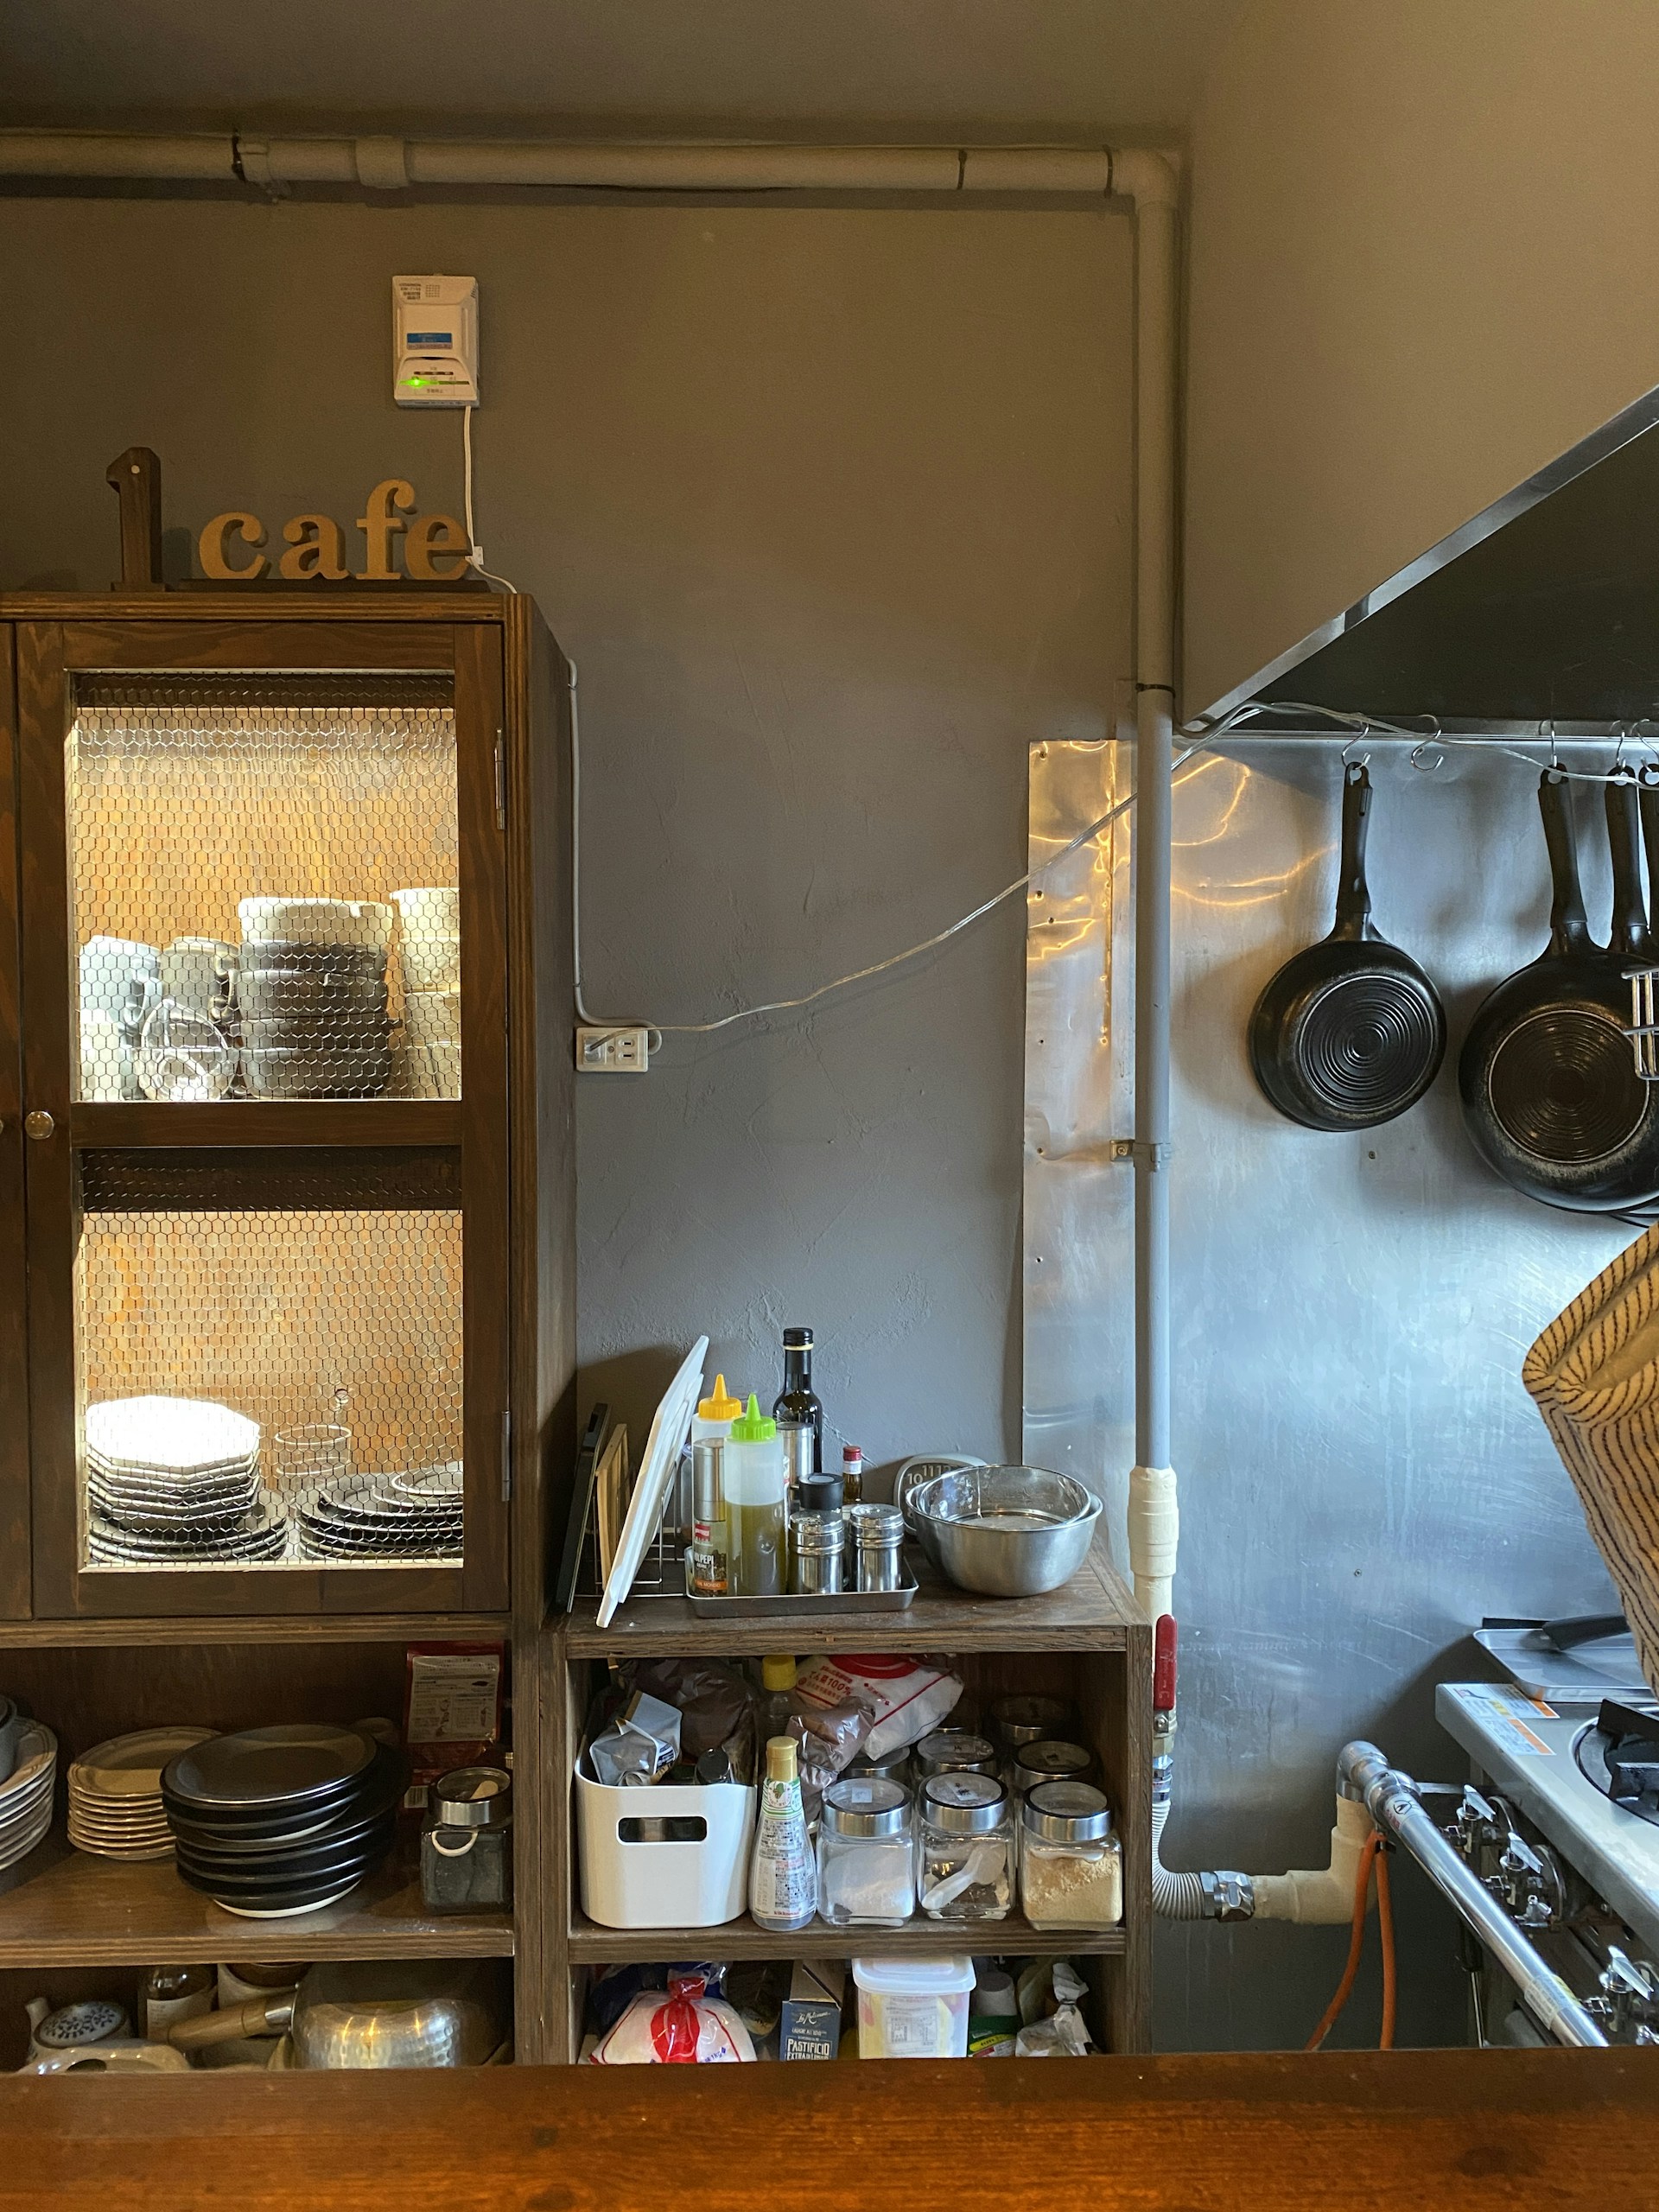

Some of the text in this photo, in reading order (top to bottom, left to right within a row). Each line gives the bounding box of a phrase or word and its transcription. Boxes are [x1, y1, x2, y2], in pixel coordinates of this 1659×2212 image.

[199, 479, 473, 581] cafe
[907, 1472, 924, 1484] 10
[922, 1465, 934, 1477] 11
[787, 2038, 830, 2056] PASTIFICIO
